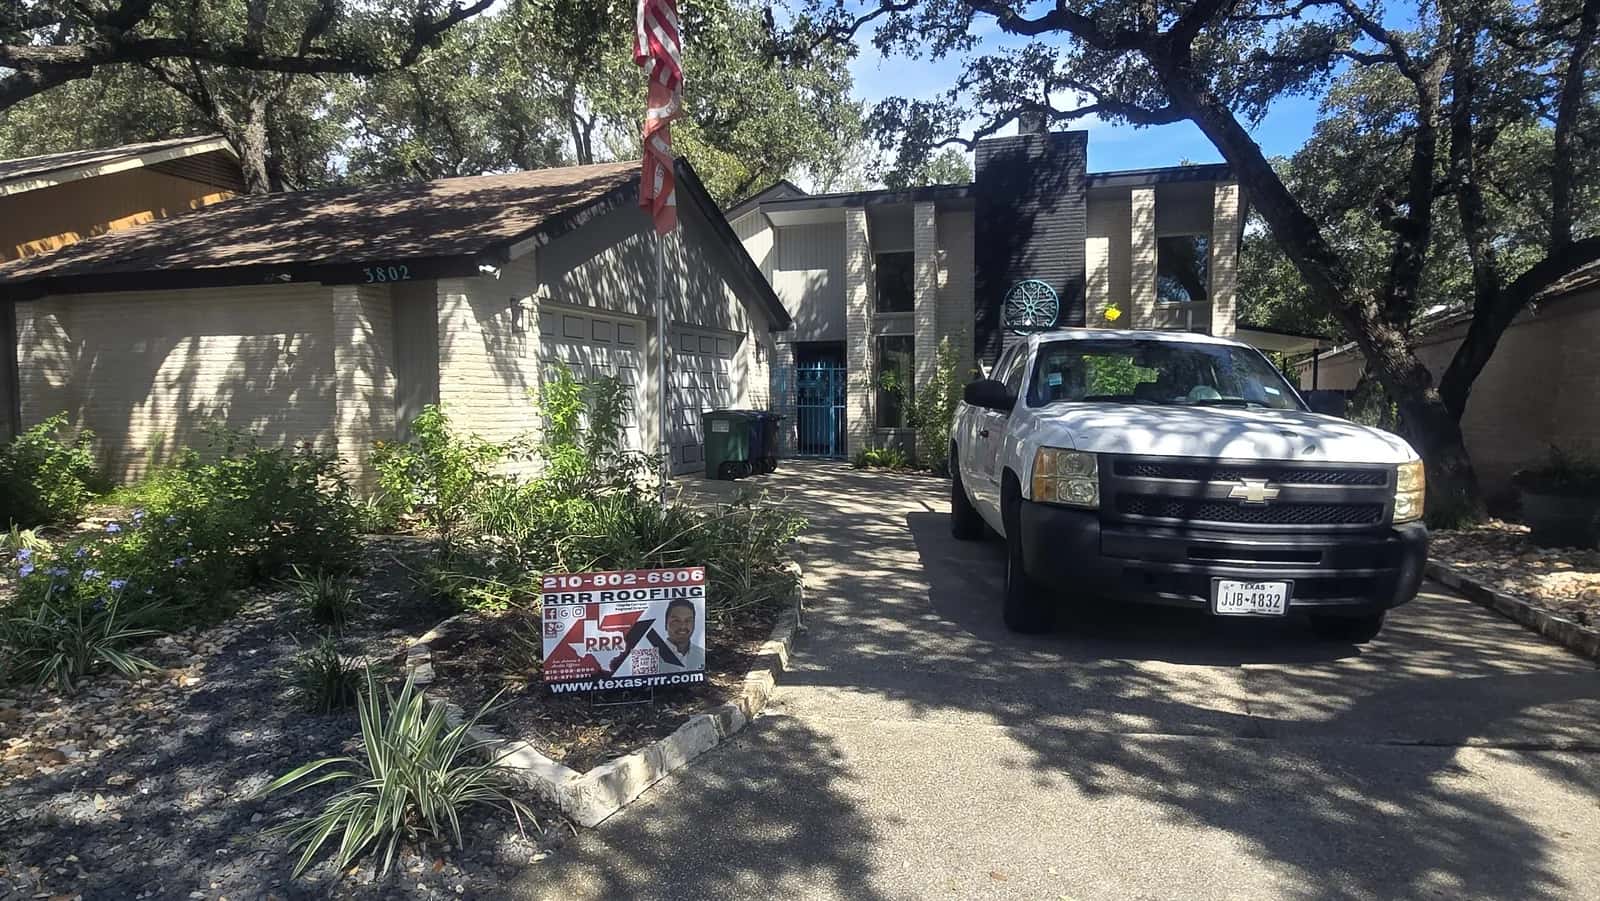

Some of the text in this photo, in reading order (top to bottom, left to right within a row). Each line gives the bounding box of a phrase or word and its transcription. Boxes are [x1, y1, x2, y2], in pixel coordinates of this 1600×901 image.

[363, 265, 411, 283] 3802
[543, 570, 704, 589] 210-802-6906
[543, 586, 703, 605] RRR ROOFING
[585, 636, 625, 652] RRR
[551, 673, 704, 693] www.texas-rrr.com
